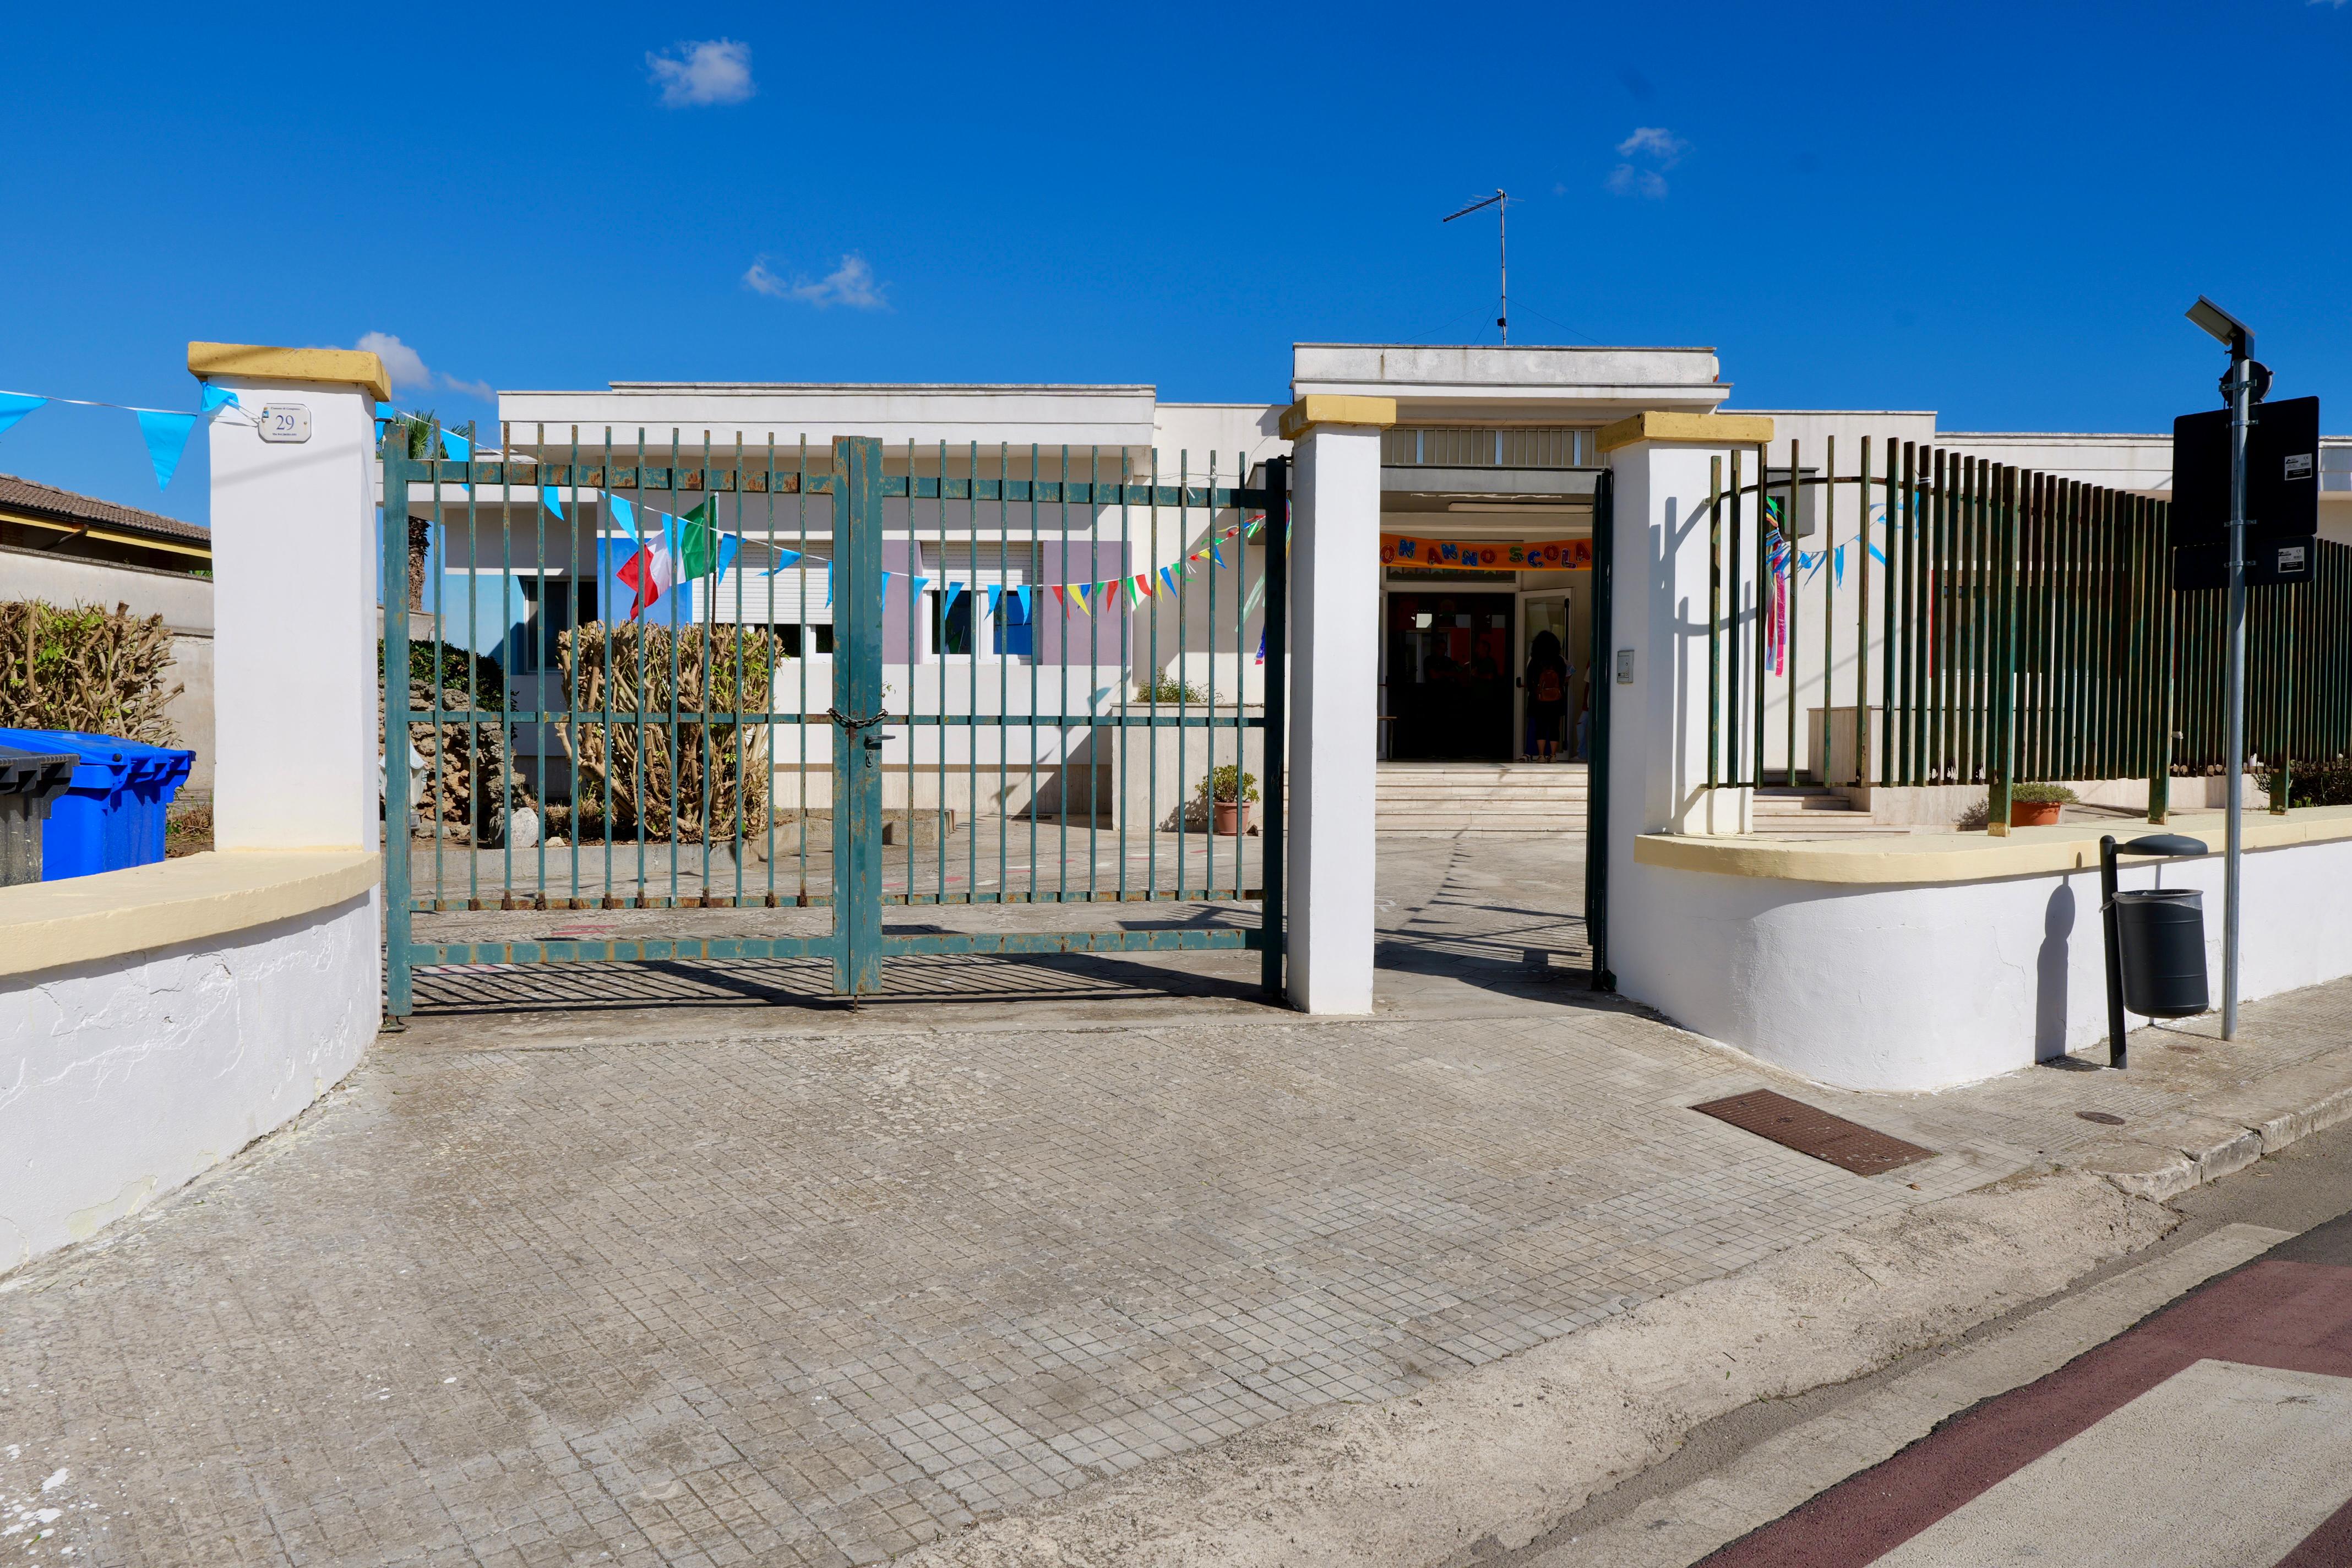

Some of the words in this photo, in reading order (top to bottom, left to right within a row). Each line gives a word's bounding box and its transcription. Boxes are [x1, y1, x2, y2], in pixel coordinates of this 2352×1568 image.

[275, 415, 295, 431] 29
[1427, 543, 1497, 567] ANNO
[1508, 542, 1592, 569] SCOLA
